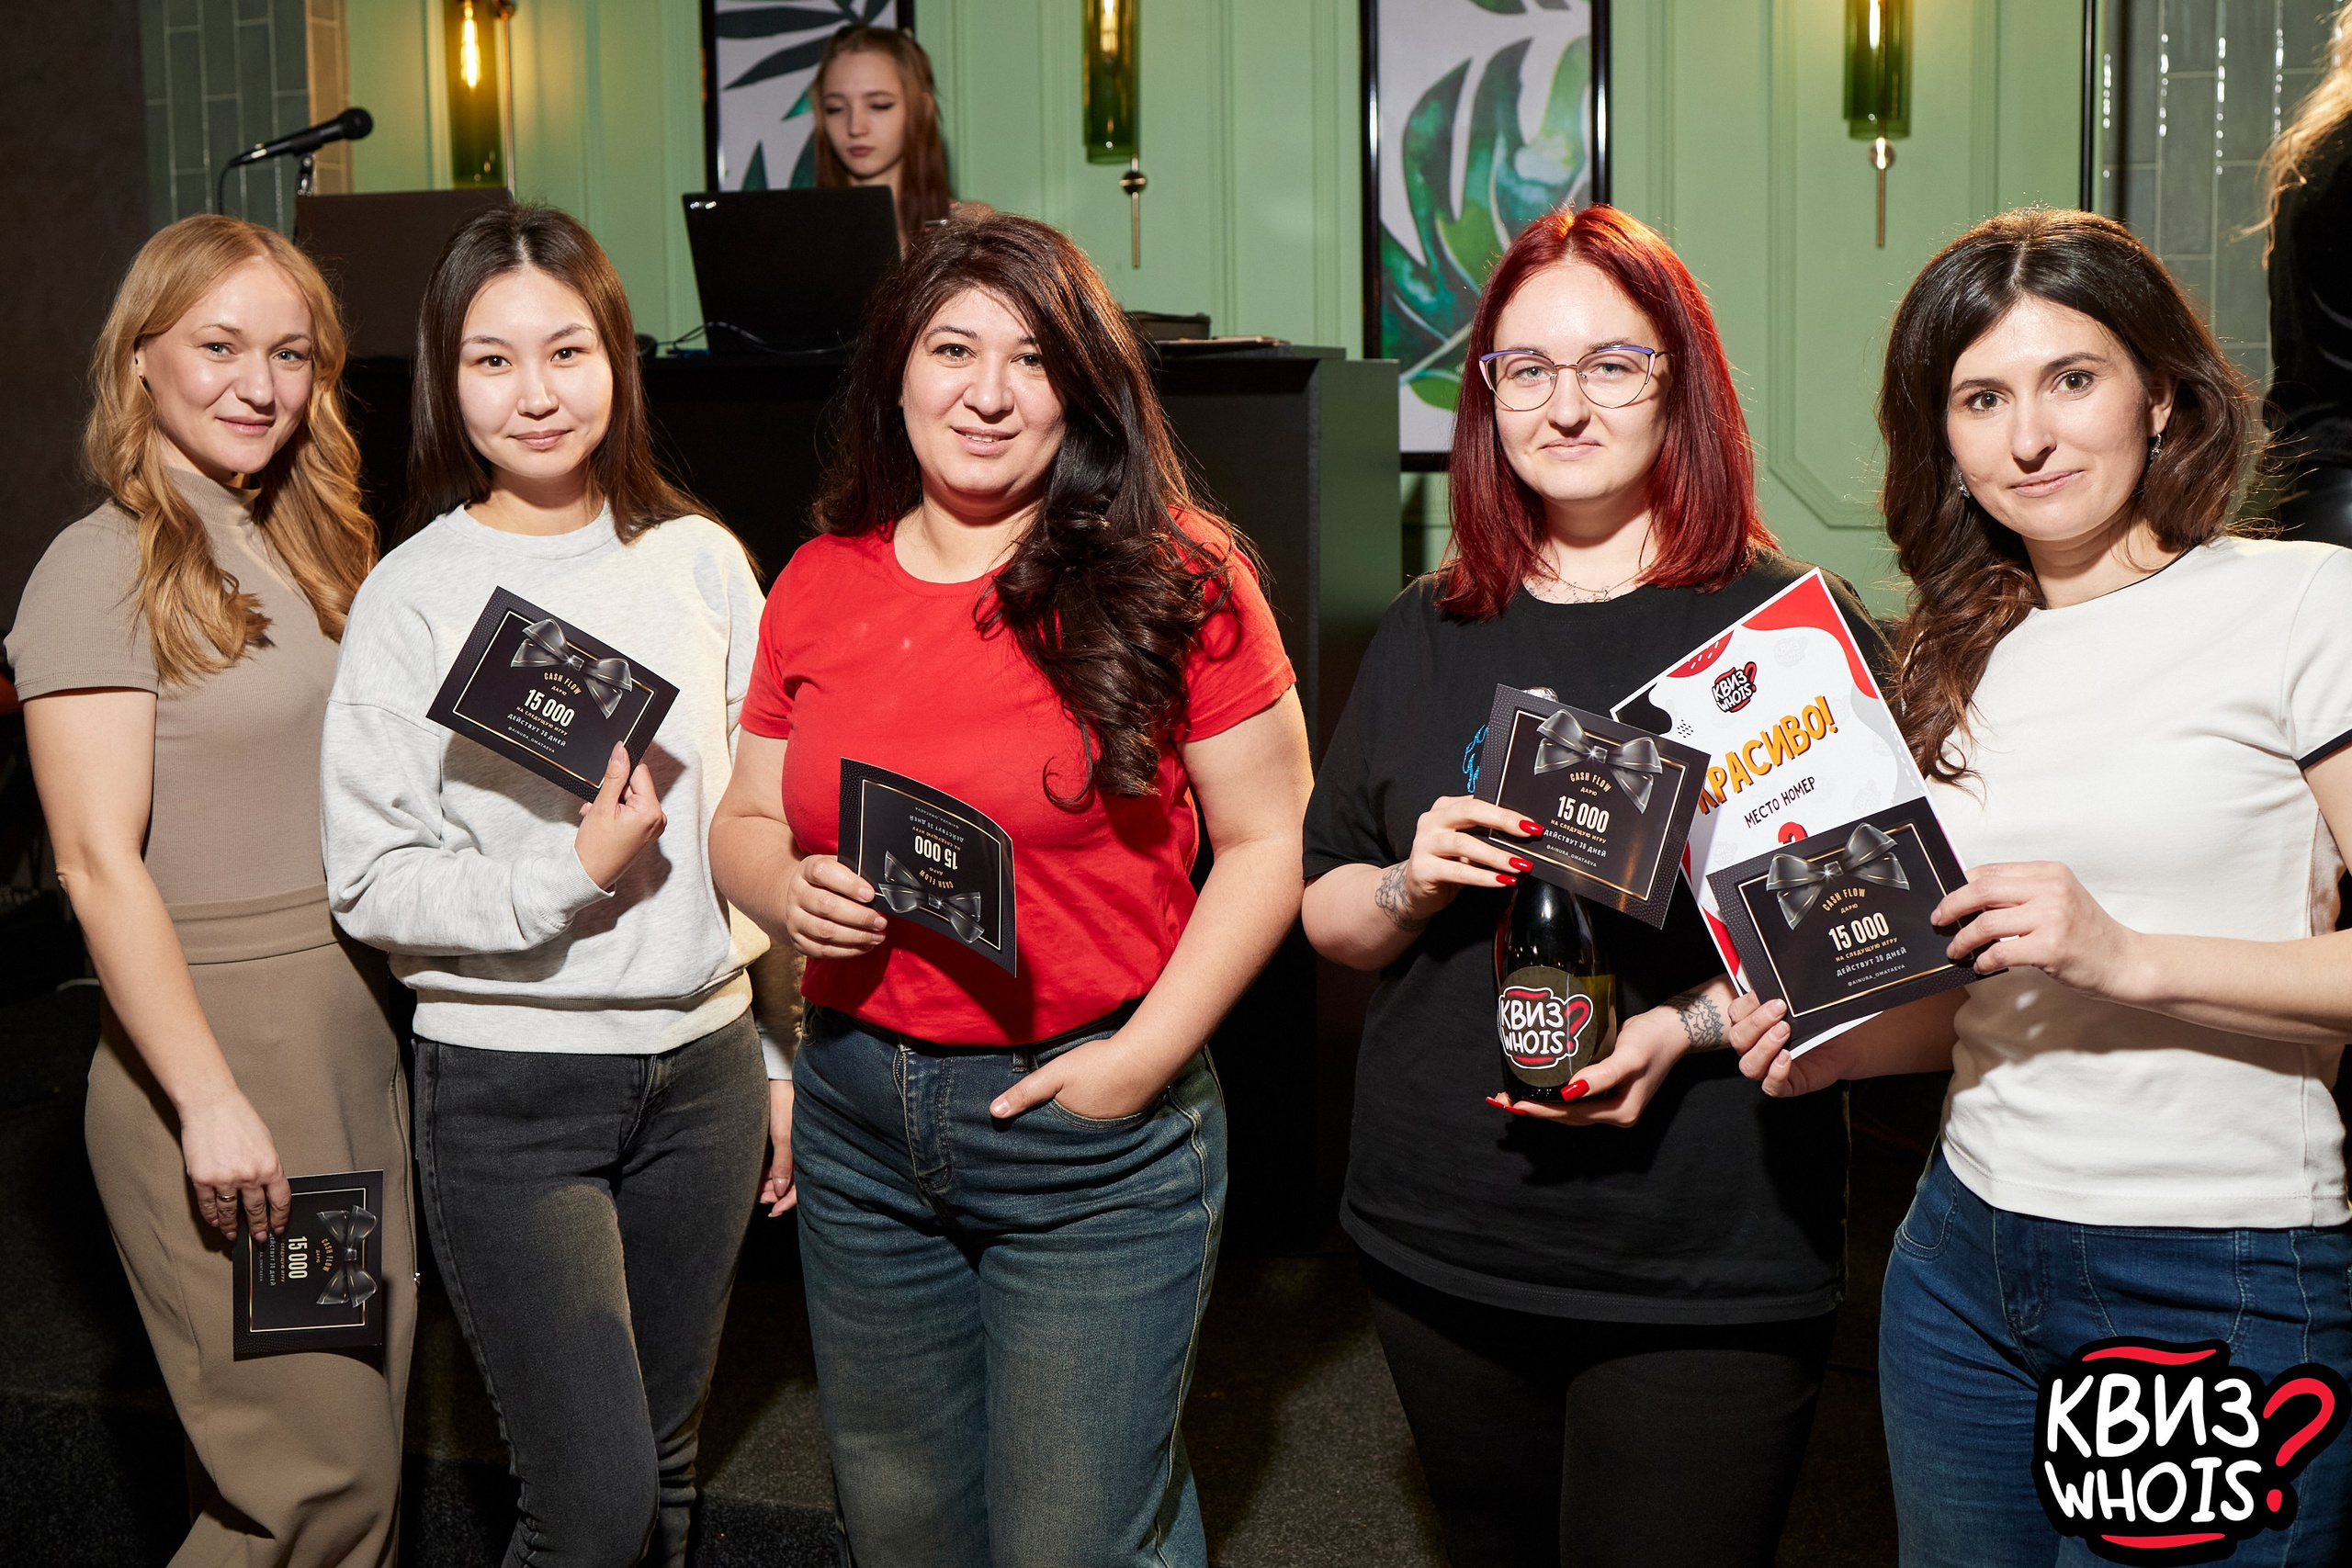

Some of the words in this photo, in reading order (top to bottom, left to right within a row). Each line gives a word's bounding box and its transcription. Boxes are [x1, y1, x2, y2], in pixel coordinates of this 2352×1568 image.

[544, 672, 563, 682] CASH
[564, 678, 582, 694] FLOW
[551, 685, 567, 696] ДАРЮ
[1713, 671, 1747, 702] КВИЗ
[1716, 682, 1752, 711] WHOIS
[525, 689, 545, 711] 15
[542, 699, 575, 727] 000
[507, 713, 540, 733] ДЕЙСТВУТ
[548, 735, 567, 747] ДНЕЙ
[554, 727, 568, 736] ИГРУ
[1570, 772, 1589, 782] CASH
[1592, 774, 1611, 792] FLOW
[1580, 786, 1598, 796] ДАРЮ
[1744, 798, 1781, 829] МЕСТО
[1781, 776, 1815, 807] НОМЕР
[909, 815, 926, 825] ДНЕЙ
[1557, 795, 1577, 820] 15
[1576, 802, 1610, 833] 000
[912, 826, 925, 834] ИГРУ
[935, 826, 964, 843] ДЕЙСТВУТ
[1591, 835, 1607, 844] ИГРУ
[914, 835, 941, 863] 000
[1544, 829, 1578, 846] ДЕЙСТВУТ
[1579, 841, 1587, 850] 30
[1587, 846, 1607, 858] ДНЕЙ
[944, 848, 958, 870] 15
[919, 869, 936, 886] FLOW
[929, 866, 943, 876] ДАРЮ
[938, 880, 954, 889] CASH
[1822, 892, 1842, 911] CASH
[1843, 887, 1865, 898] FLOW
[1840, 903, 1859, 914] ДАРЮ
[1828, 924, 1852, 952] 15
[1850, 912, 1889, 943] 000
[1882, 937, 1897, 946] ИГРУ
[1837, 958, 1874, 977] ДЕЙСТВУТ
[1875, 954, 1883, 963] 30
[1885, 946, 1907, 961] ДНЕЙ
[1848, 964, 1905, 987] @AINURA_OMATAEVA
[1500, 999, 1564, 1031] КВИЗ
[1501, 1027, 1566, 1055] WHOIS
[288, 1235, 308, 1250] 15
[321, 1238, 333, 1254] CASH
[288, 1253, 308, 1279] 000
[322, 1256, 334, 1272] FLOW
